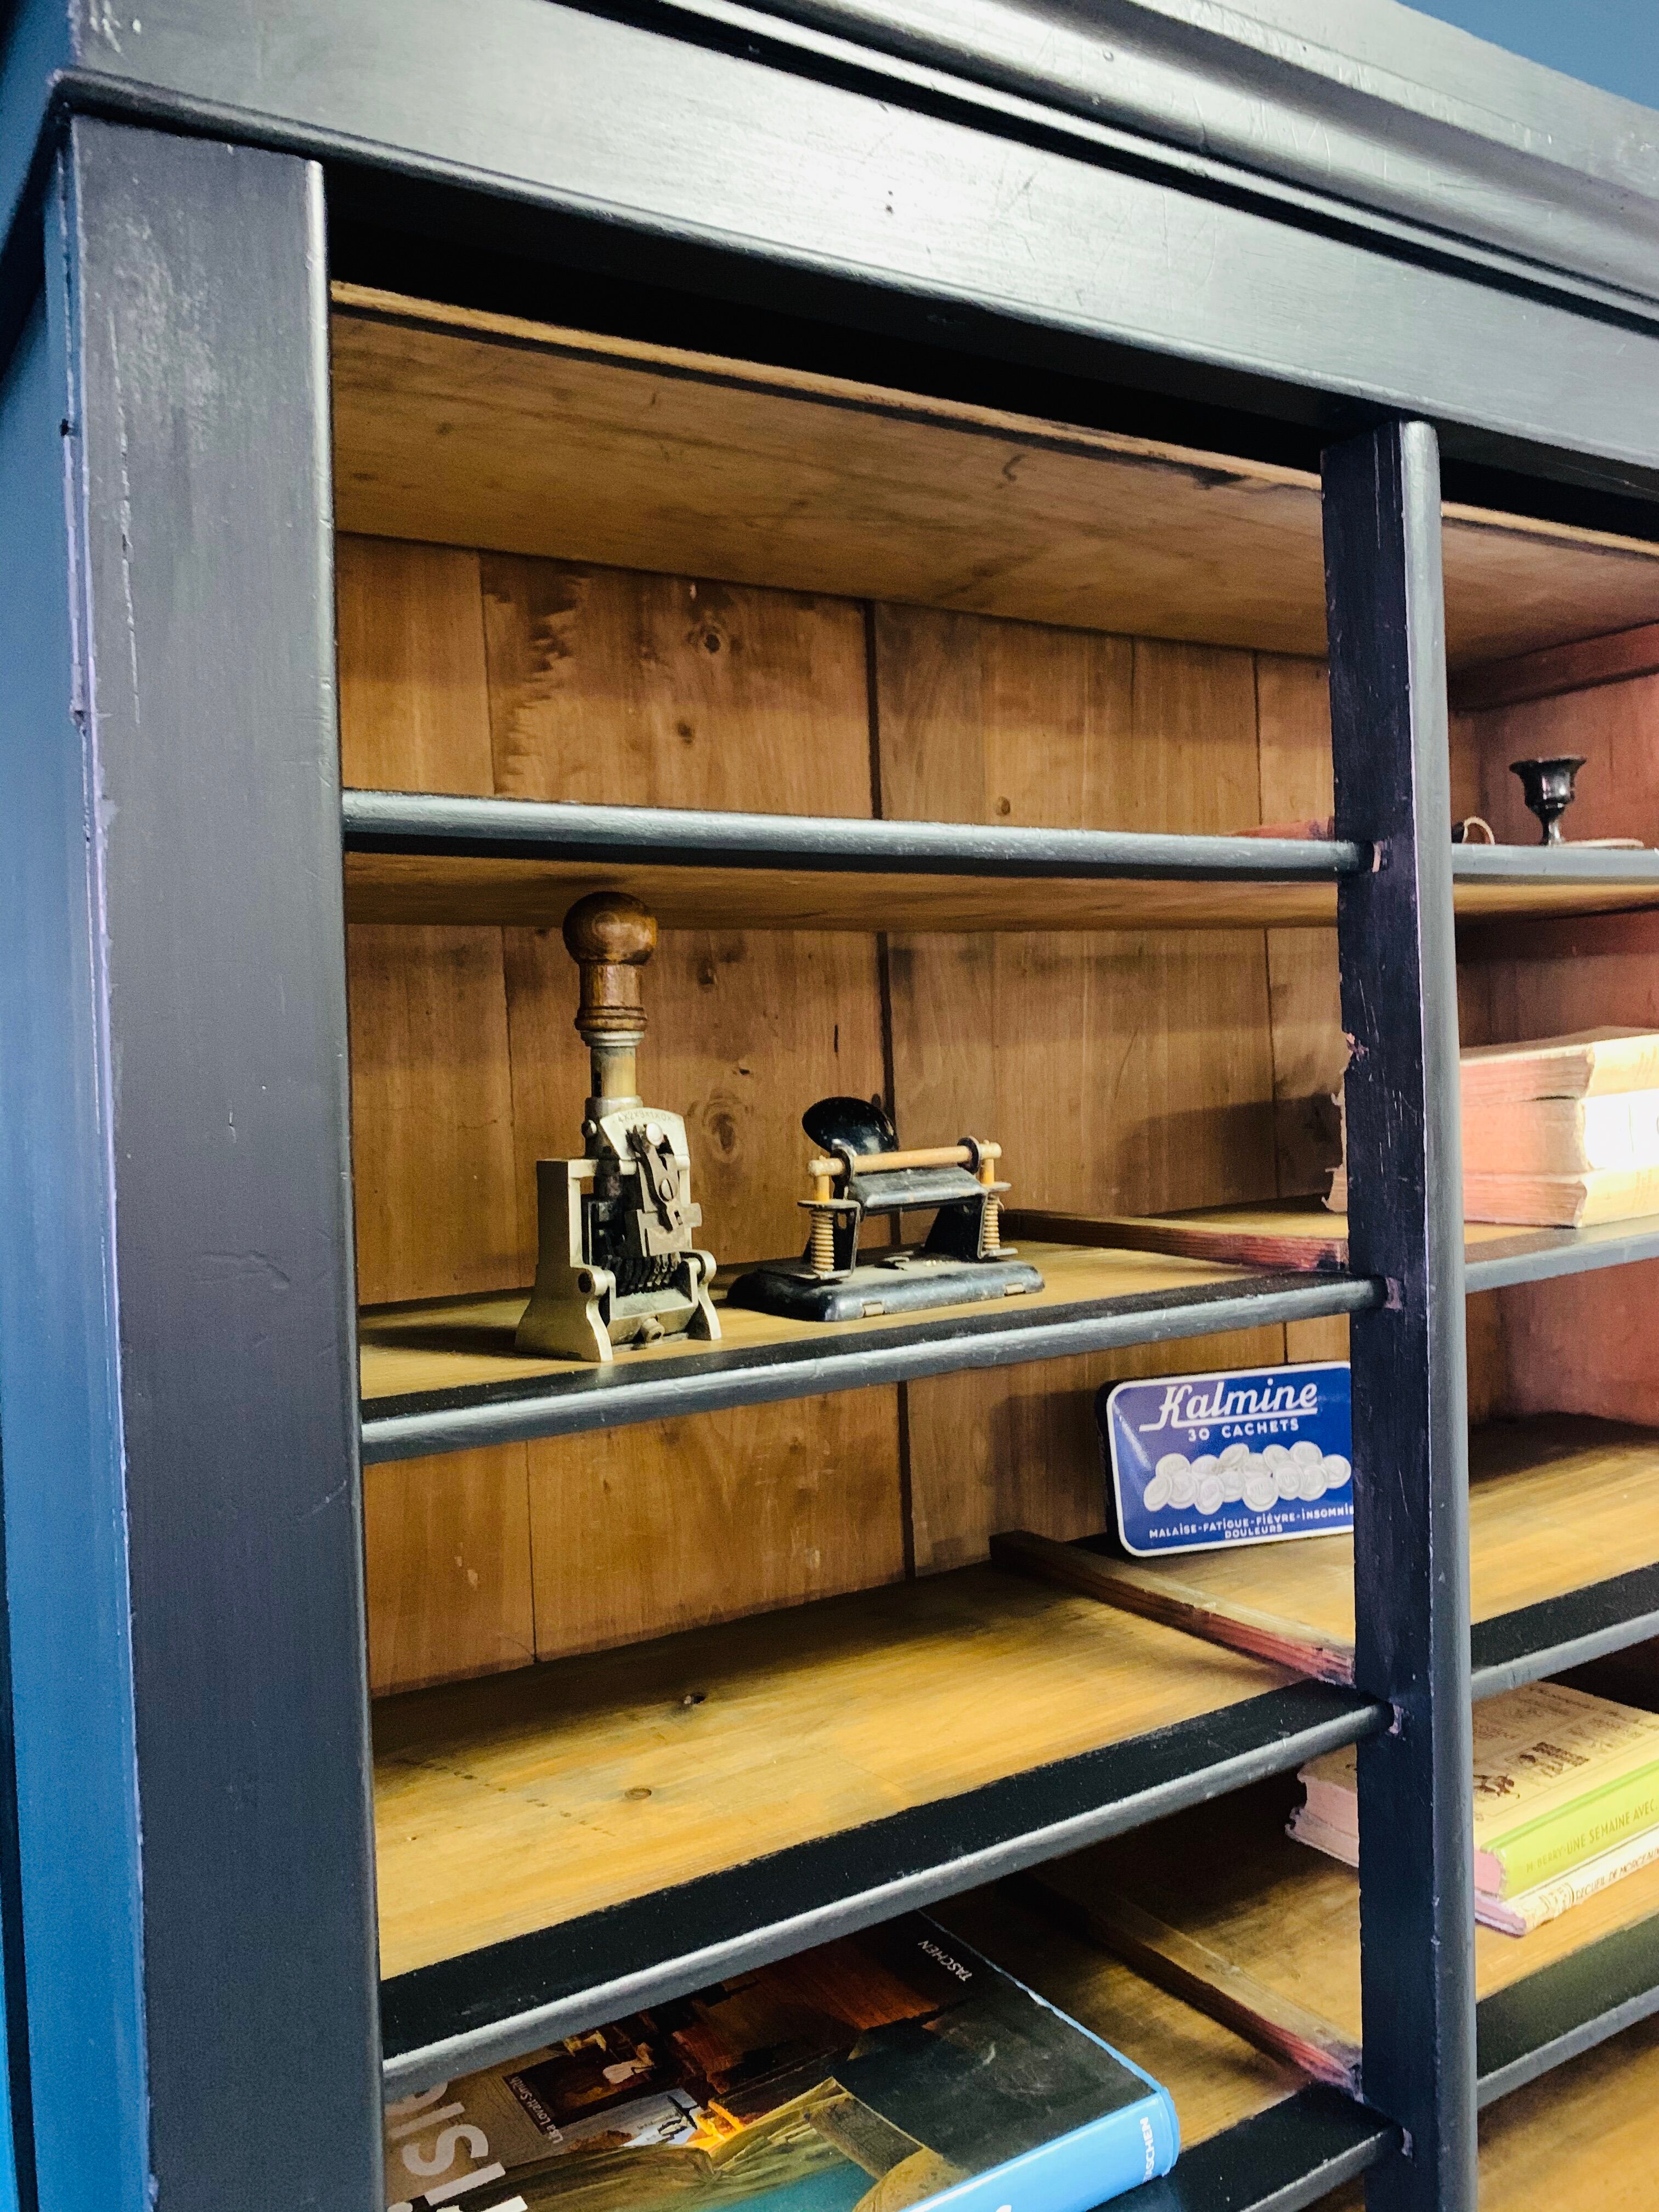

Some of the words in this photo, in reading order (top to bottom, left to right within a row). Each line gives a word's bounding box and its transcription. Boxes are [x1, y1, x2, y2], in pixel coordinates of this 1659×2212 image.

[1139, 1378, 1317, 1431] Kalmine
[1188, 1427, 1210, 1442] 30
[1221, 1418, 1299, 1438] CACHETS
[1224, 1525, 1283, 1539] DOULEURS
[1589, 1812, 1630, 1844] SEMAINE
[917, 1940, 972, 1982] TASCHEN
